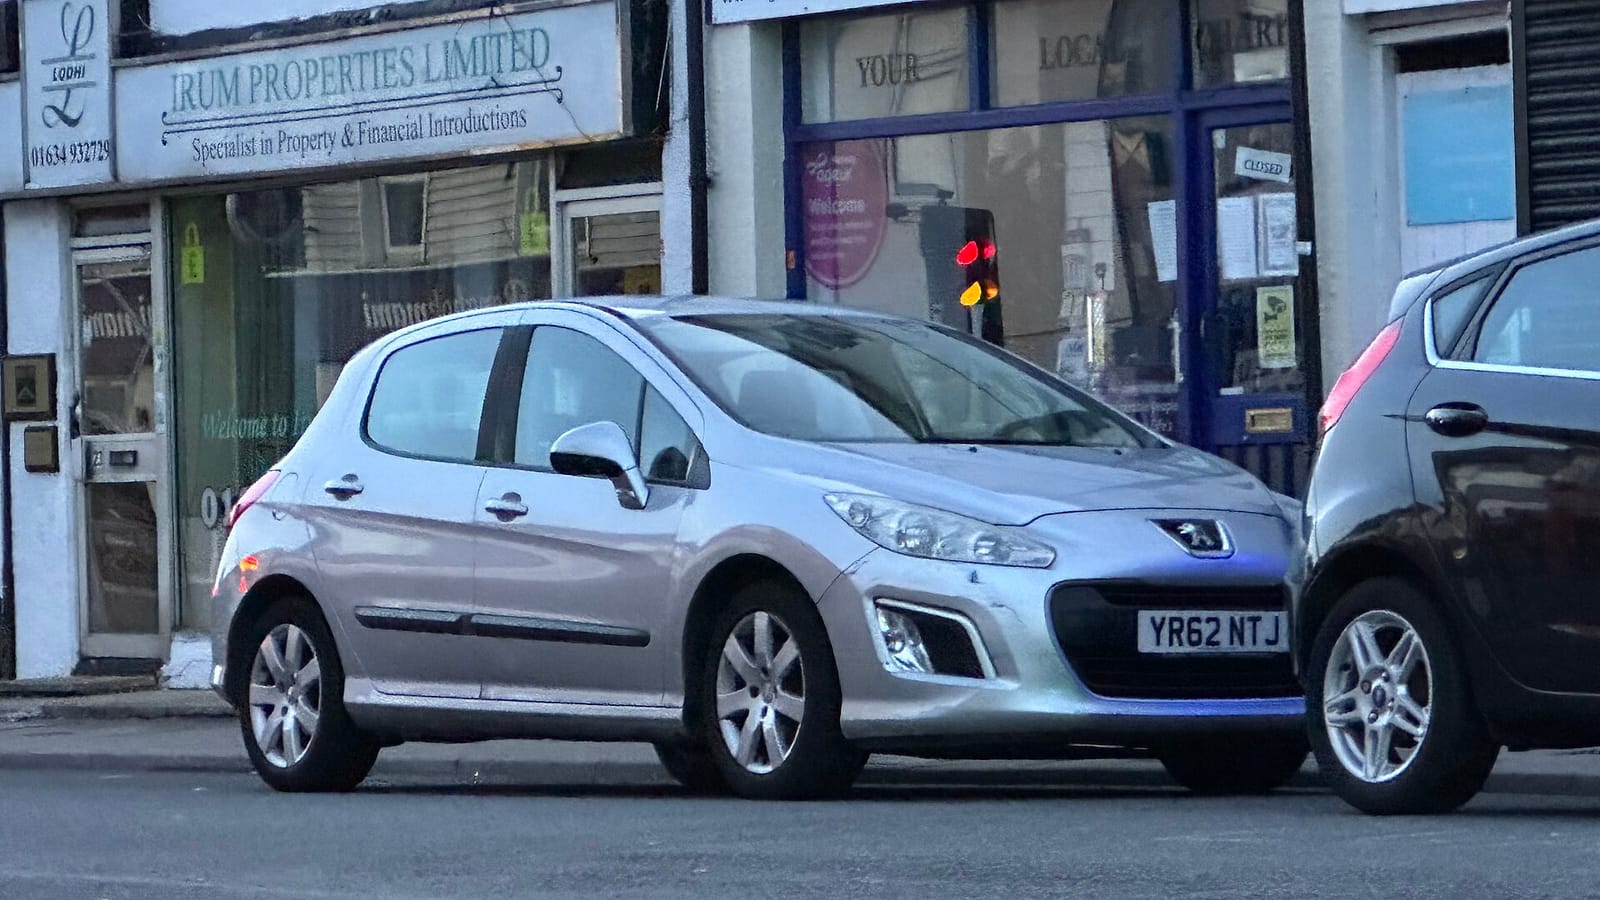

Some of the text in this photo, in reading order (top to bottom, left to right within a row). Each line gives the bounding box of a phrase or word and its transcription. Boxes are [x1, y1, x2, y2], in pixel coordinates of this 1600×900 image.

[53, 64, 86, 82] LODHI
[171, 27, 551, 113] IRUM PROPERTIES LIMITED
[856, 53, 920, 88] YOUR
[192, 103, 527, 168] Specialist in Property & Financial Introductions
[31, 139, 110, 168] 01634 932729
[1244, 159, 1283, 176] CLOSED
[201, 409, 267, 439] Welcome
[272, 414, 287, 437] to
[1150, 616, 1280, 647] YR62 NTJ
